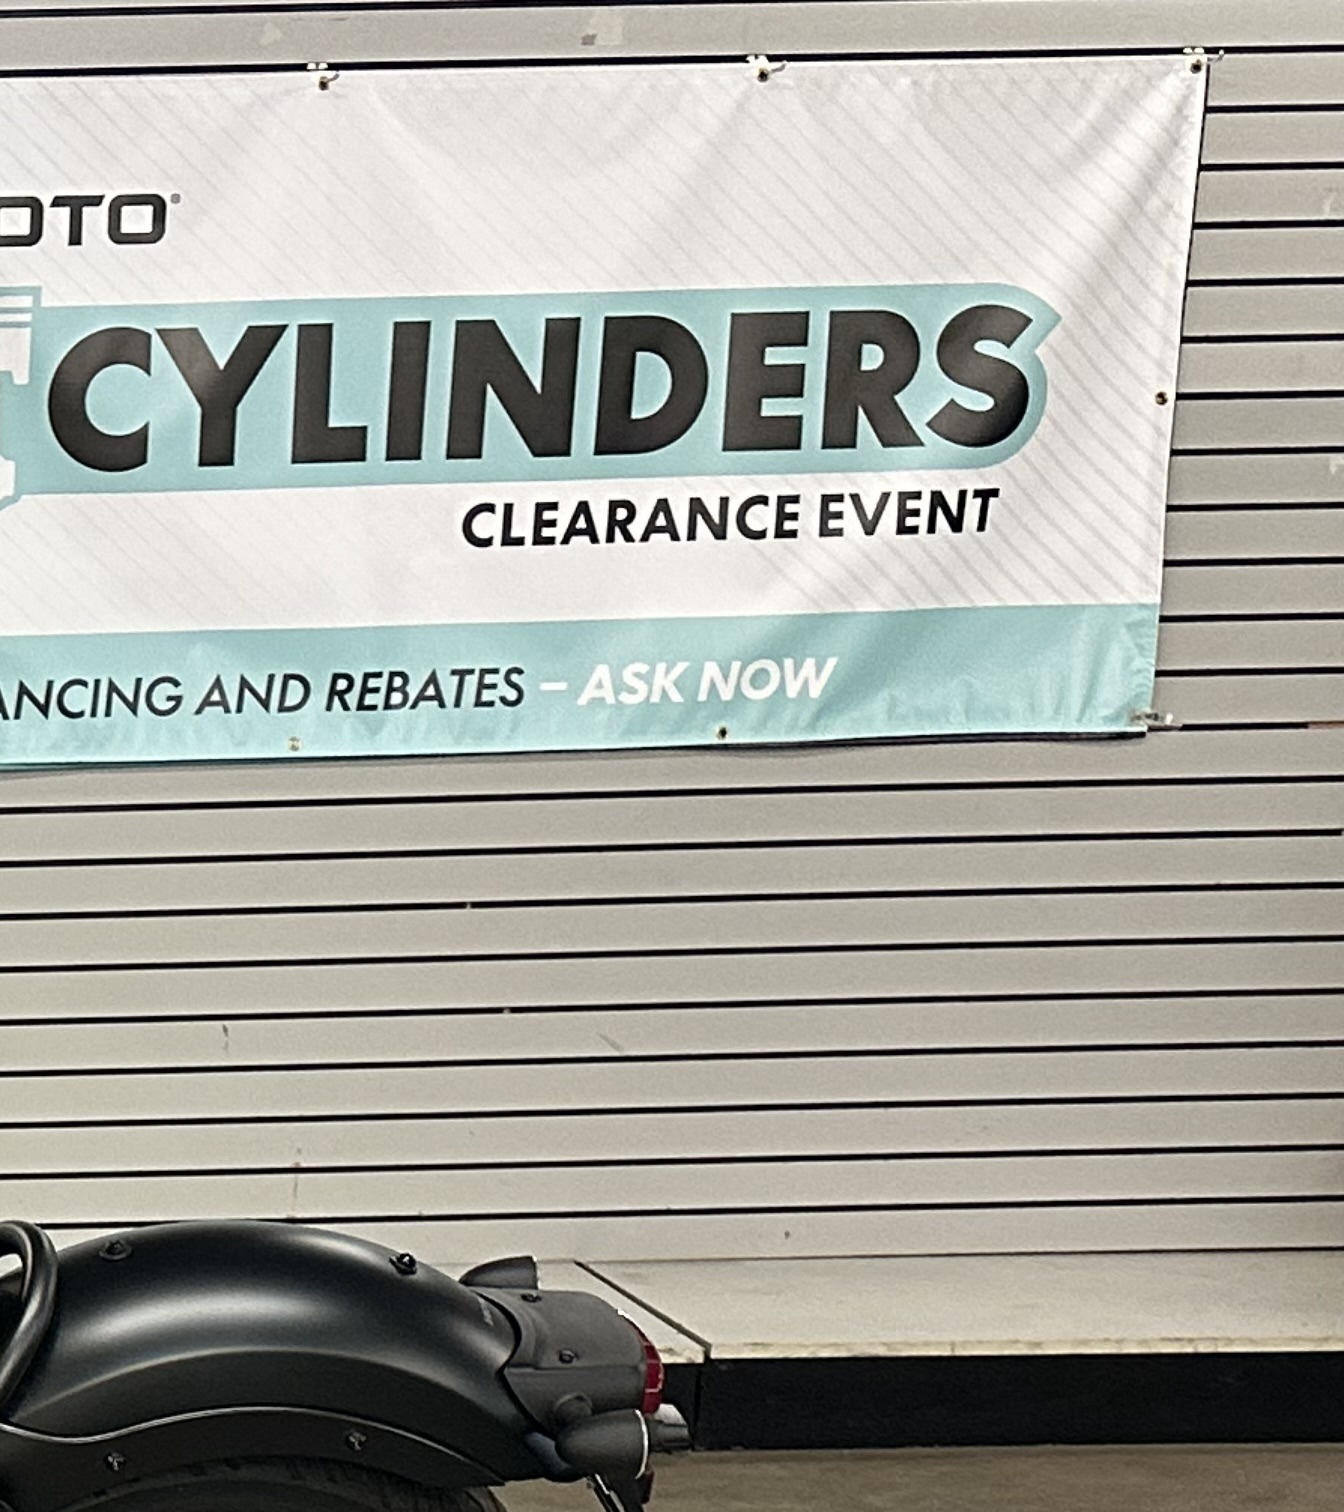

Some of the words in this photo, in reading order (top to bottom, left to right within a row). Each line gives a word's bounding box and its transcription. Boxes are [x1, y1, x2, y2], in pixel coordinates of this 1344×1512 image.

[47, 303, 1034, 473] CYLINDERS
[462, 494, 800, 548] CLEARANCE
[817, 487, 1001, 538] EVENT
[194, 672, 311, 716] AND
[324, 666, 526, 713] REBATES
[576, 660, 688, 706] ASK
[697, 656, 838, 704] NOW
